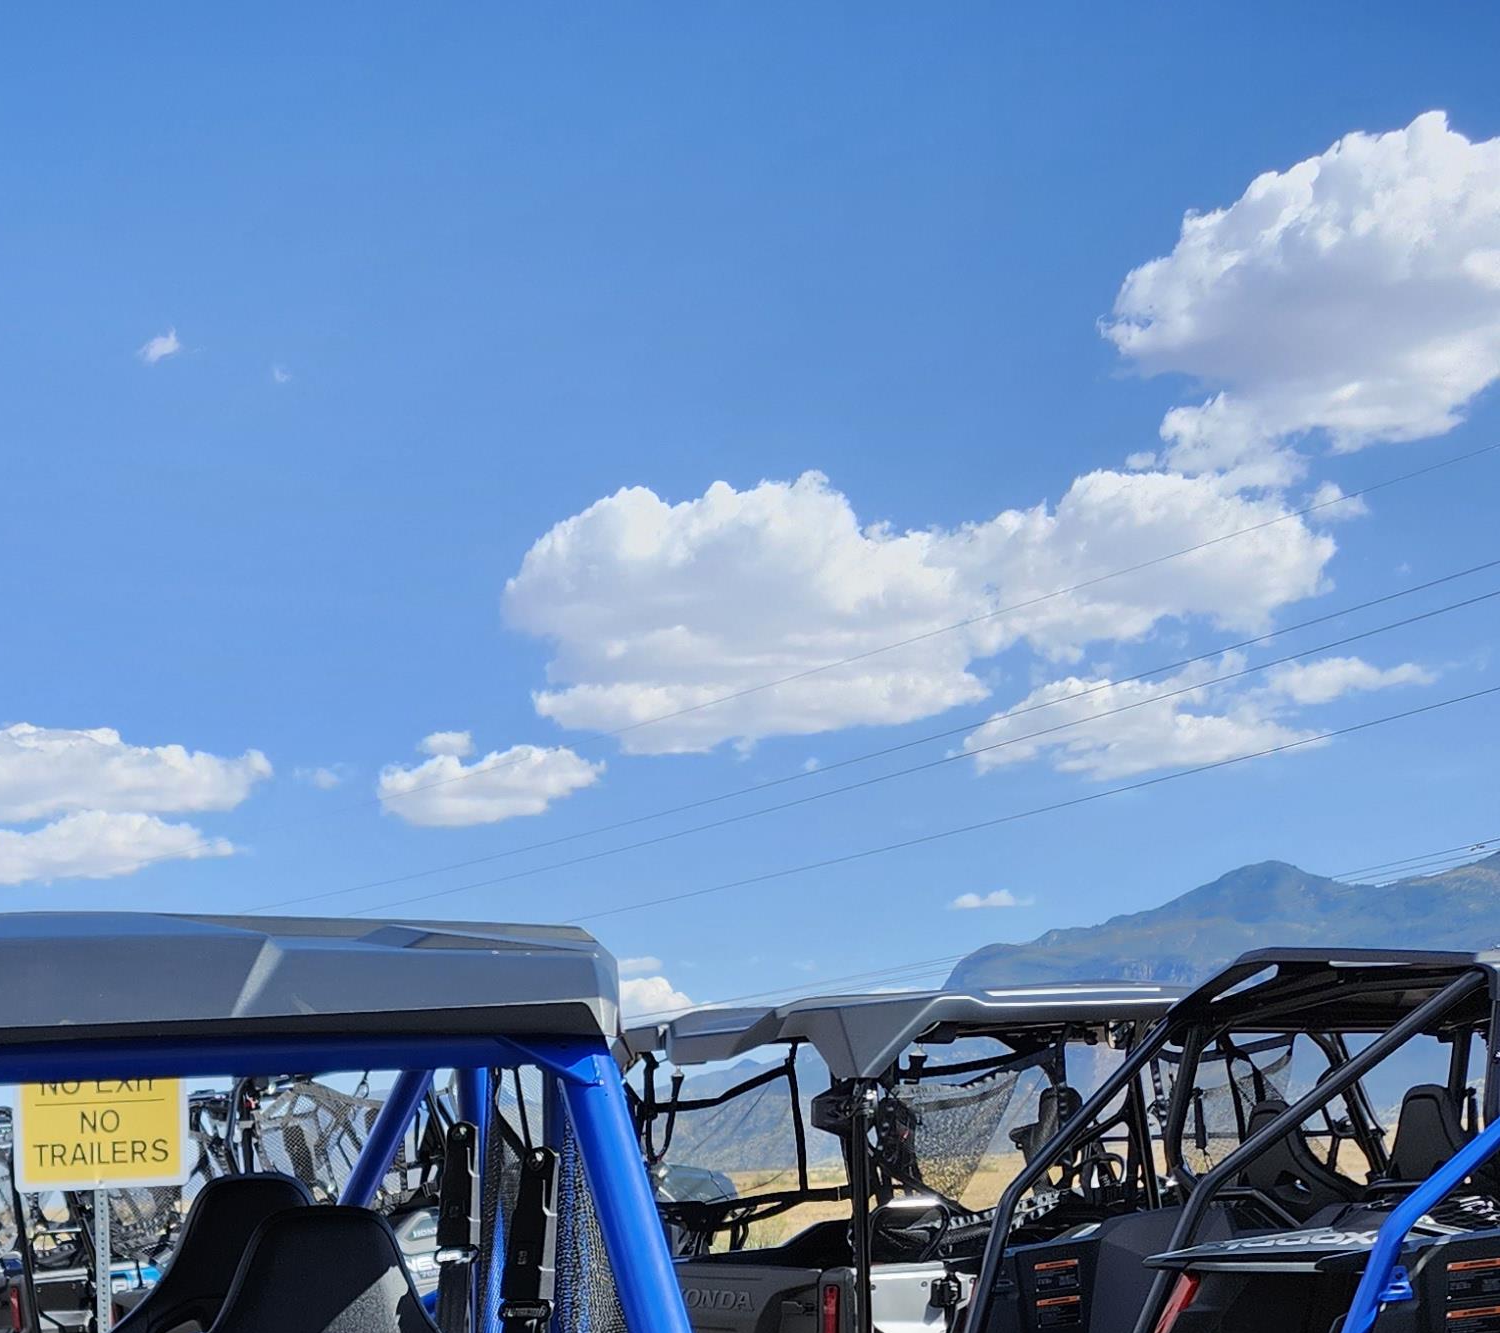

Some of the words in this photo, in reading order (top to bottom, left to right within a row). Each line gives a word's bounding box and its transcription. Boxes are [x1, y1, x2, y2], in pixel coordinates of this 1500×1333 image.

[80, 1109, 121, 1134] NO
[33, 1138, 170, 1168] TRAILERS
[681, 1288, 754, 1312] ONDA
